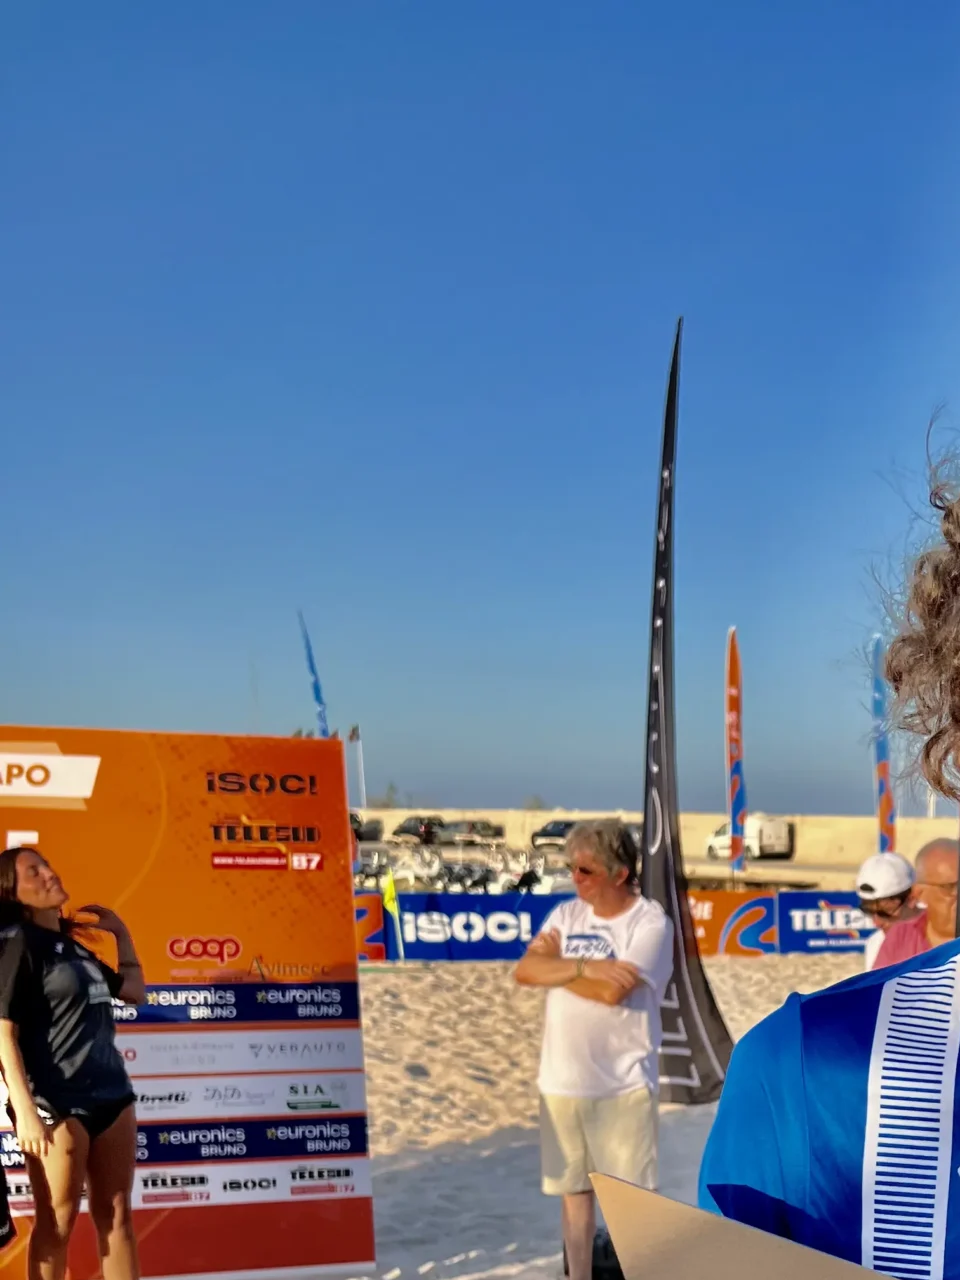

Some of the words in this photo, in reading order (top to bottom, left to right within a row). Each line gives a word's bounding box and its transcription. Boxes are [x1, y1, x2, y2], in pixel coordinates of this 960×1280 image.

[168, 937, 241, 966] coop
[159, 987, 235, 1006] euronics
[268, 986, 341, 1004] euronics
[190, 1005, 237, 1020] BRUNO
[297, 1004, 342, 1017] BRUNO
[170, 1125, 246, 1145] euronics
[277, 1121, 350, 1140] euronics
[201, 1143, 247, 1157] BRUNO
[306, 1140, 351, 1153] BRUNO
